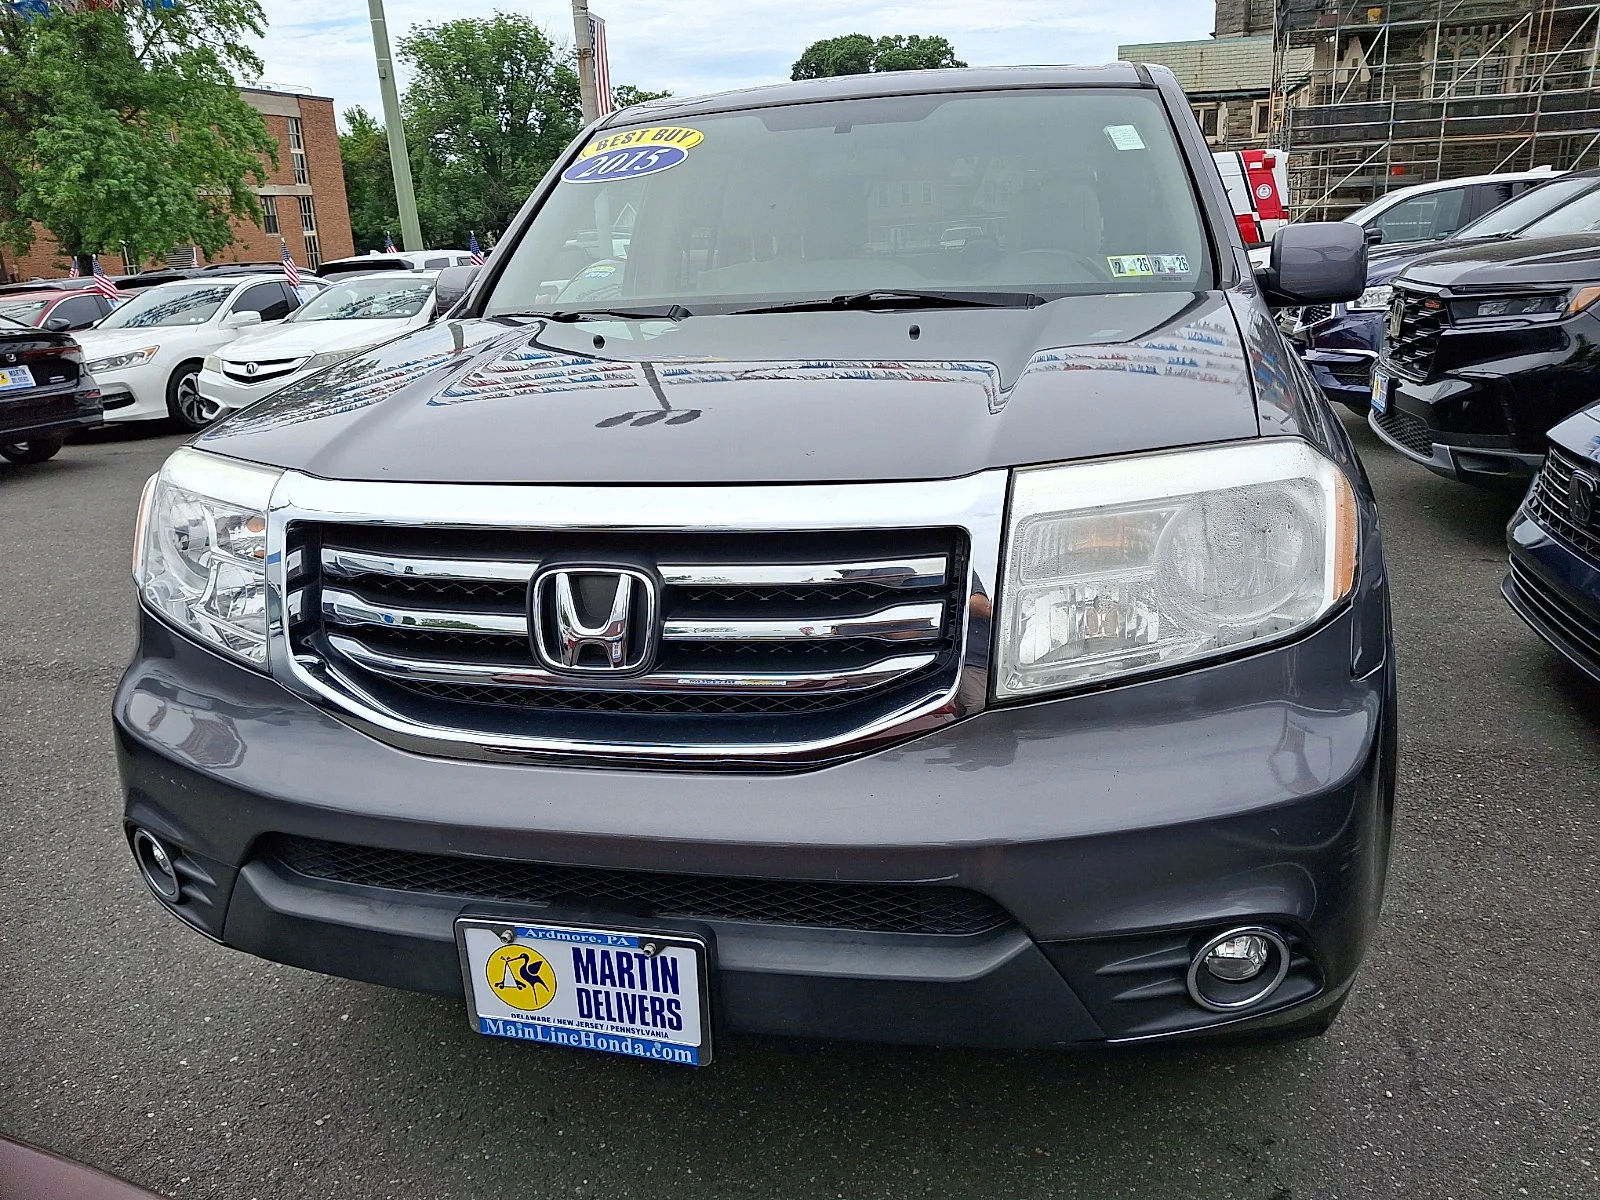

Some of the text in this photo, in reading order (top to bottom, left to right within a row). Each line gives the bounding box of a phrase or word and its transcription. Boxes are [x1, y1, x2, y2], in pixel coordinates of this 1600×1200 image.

[596, 128, 696, 152] BEST BUY
[574, 148, 672, 180] 2015
[1114, 257, 1150, 274] 2 26
[1154, 256, 1189, 272] 2 26
[525, 929, 631, 947] Ardmore, PA
[571, 946, 680, 996] MARTIN
[576, 987, 683, 1032] DELIVERS
[510, 1013, 551, 1024] DELAWARE
[556, 1018, 574, 1027] NEW
[575, 1020, 605, 1031] JERSEY
[610, 1024, 670, 1040] PENNSYLVANIA
[485, 1018, 693, 1063] MainLineHonda.com
